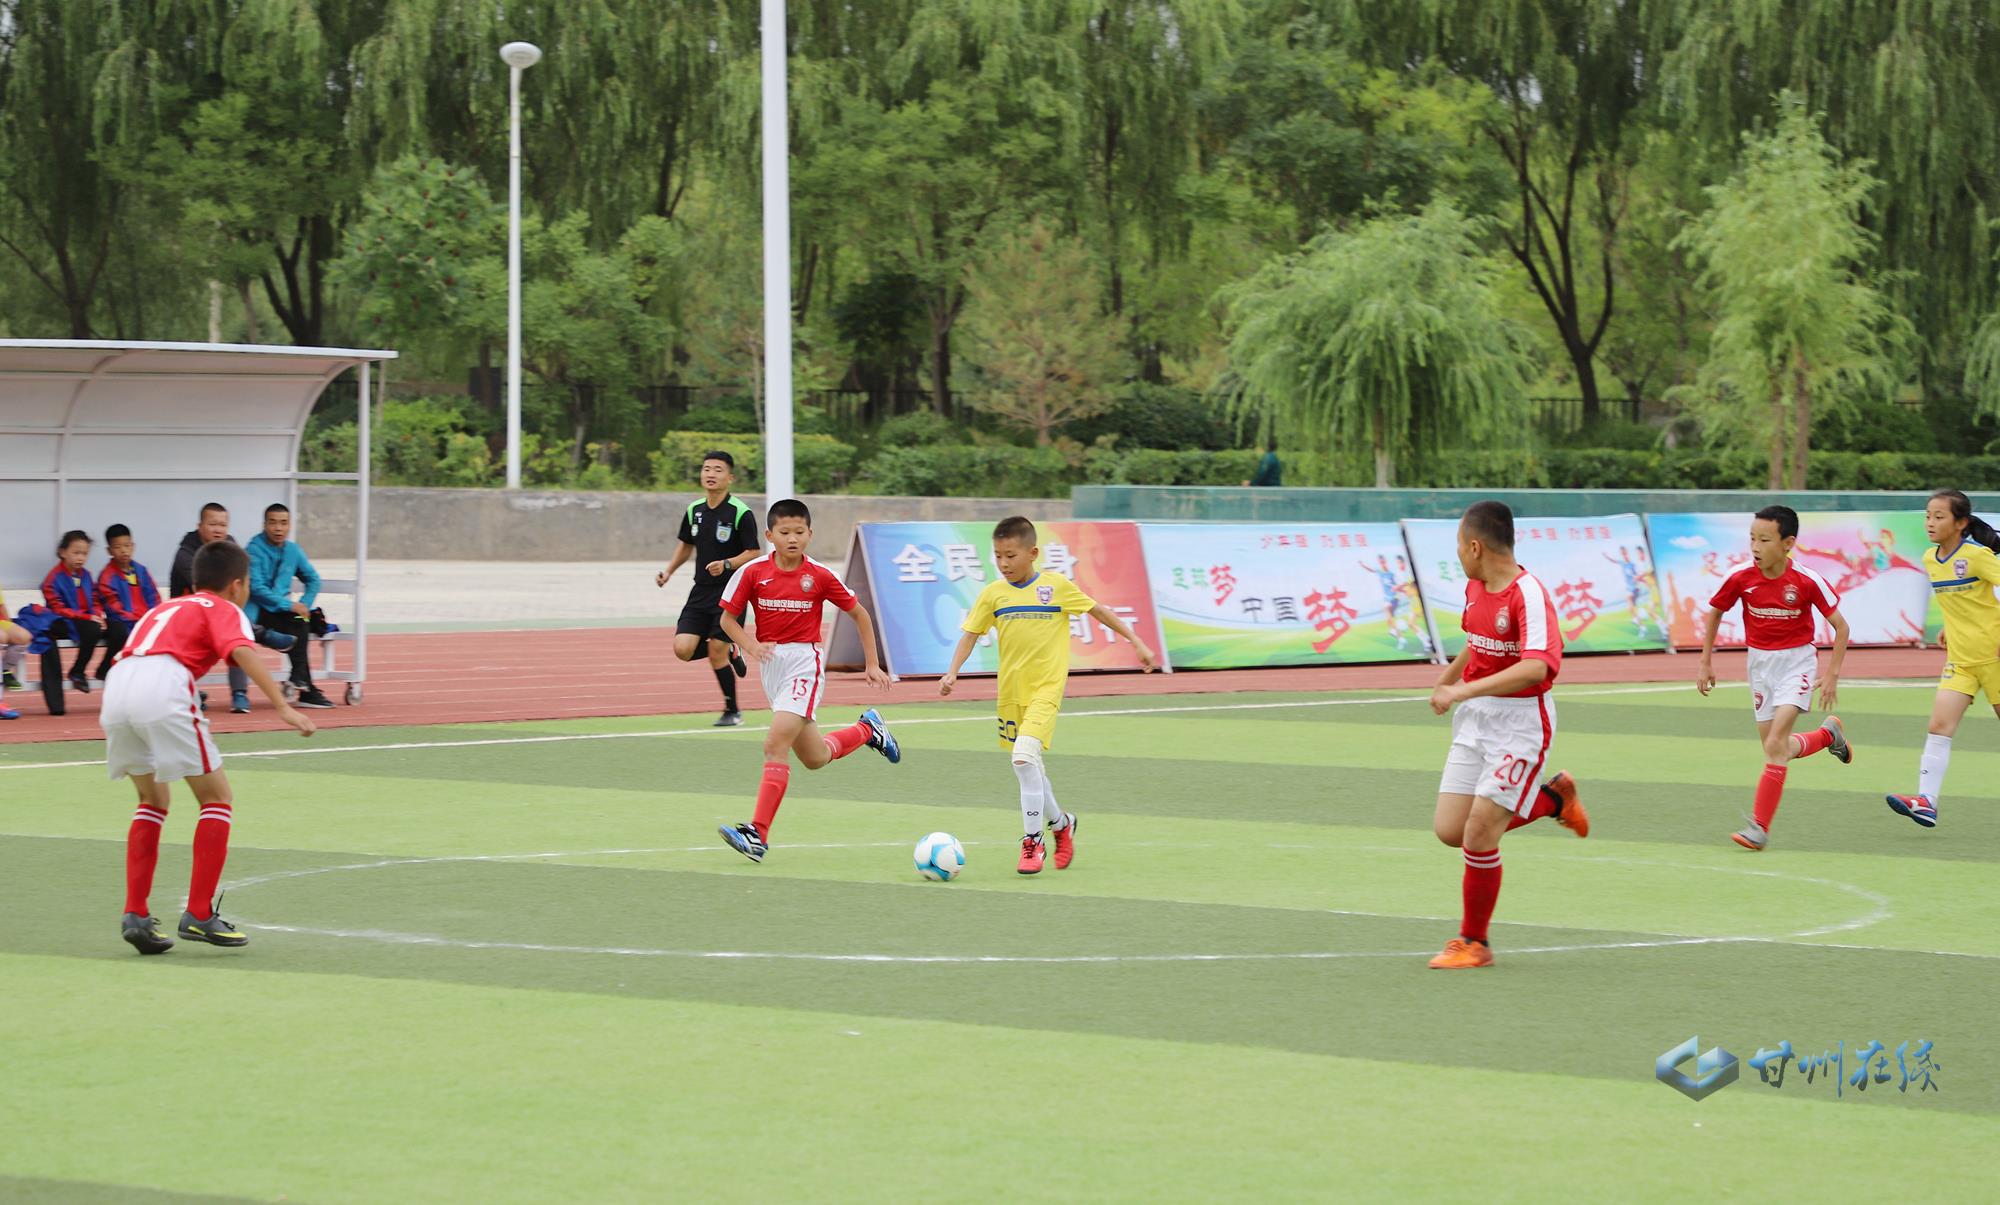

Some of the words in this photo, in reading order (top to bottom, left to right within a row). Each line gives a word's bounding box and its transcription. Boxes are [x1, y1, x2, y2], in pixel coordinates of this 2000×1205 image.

[893, 542, 1079, 583] 全民身
[792, 678, 808, 697] 13
[1494, 754, 1528, 786] 20
